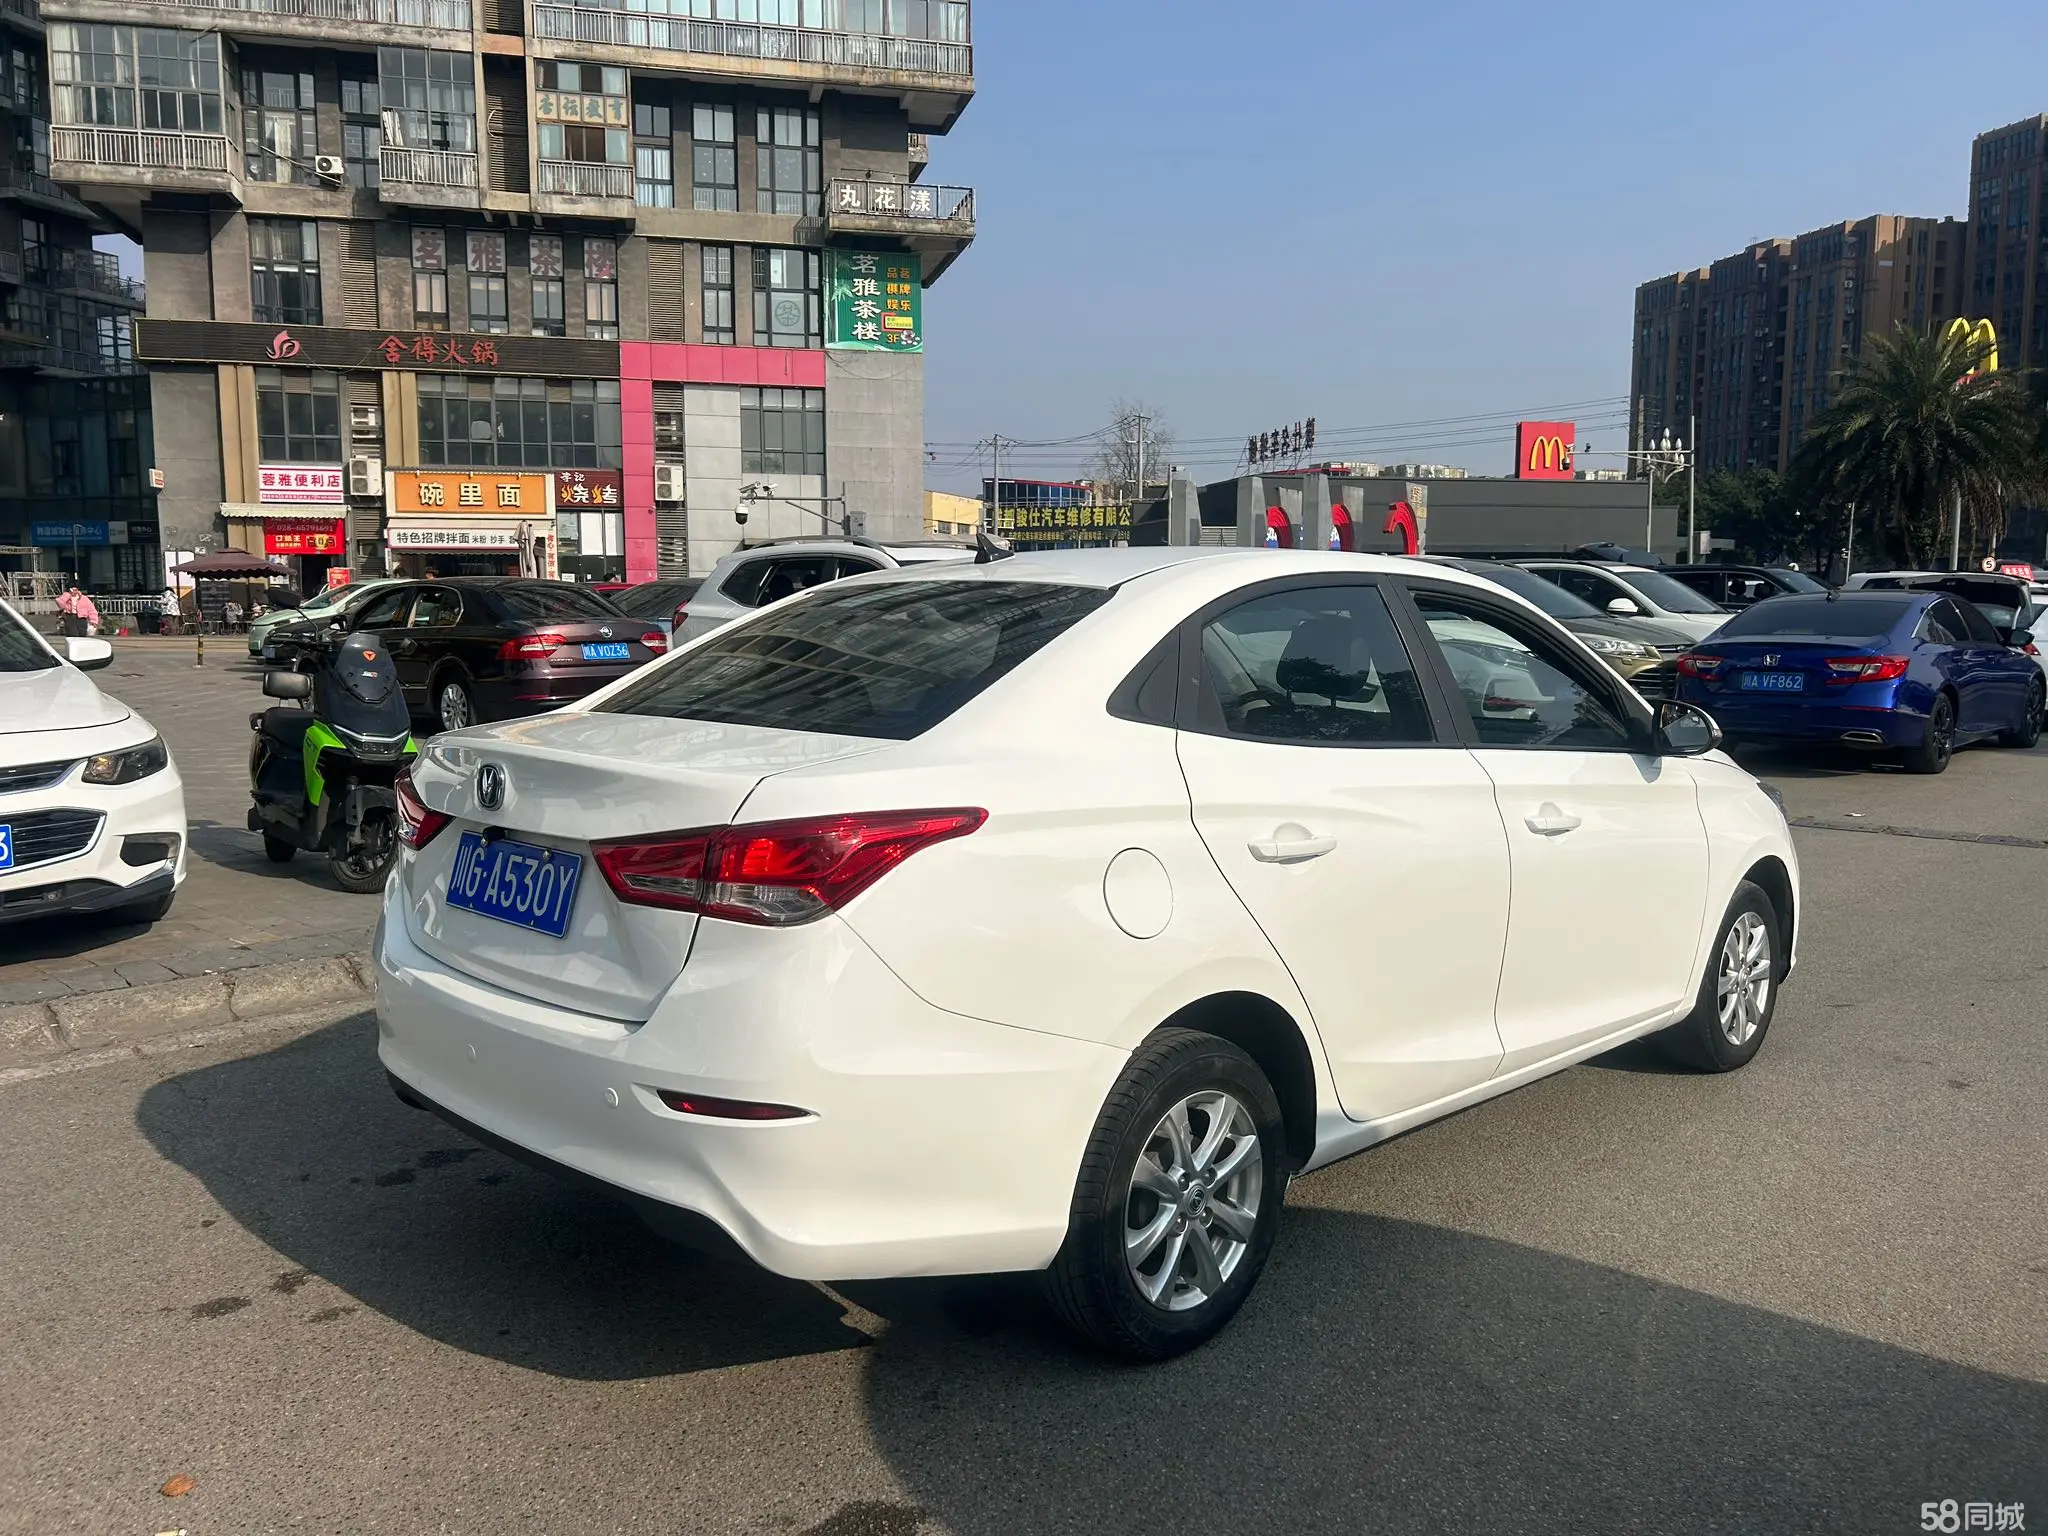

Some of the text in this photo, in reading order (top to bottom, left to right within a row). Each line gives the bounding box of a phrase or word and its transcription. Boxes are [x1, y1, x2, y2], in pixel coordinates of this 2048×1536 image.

[415, 231, 615, 280] 茗雅茶楼
[851, 254, 881, 341] 茗雅茶楼
[886, 283, 911, 295] 棋牌
[886, 299, 911, 311] 娱乐
[887, 333, 899, 343] 3F
[377, 335, 498, 366] 舍得火锅
[262, 473, 340, 488] 蓉雅便利店
[419, 482, 521, 507] 碗里面
[561, 483, 618, 504] 烧烤
[397, 532, 470, 545] 特色招牌拌面
[490, 535, 505, 544] 抄手
[451, 845, 574, 922] 川G·A530Y
